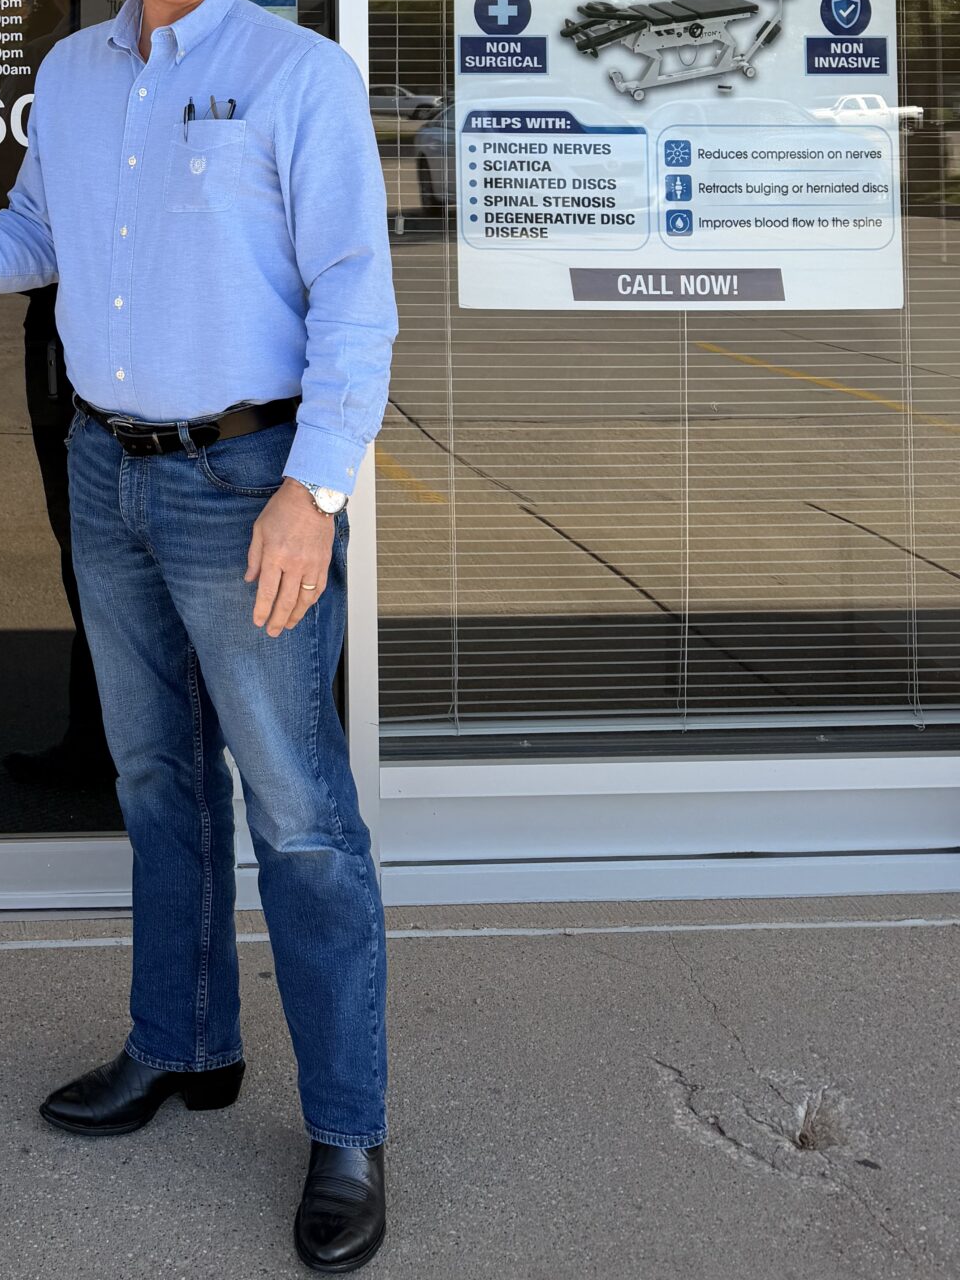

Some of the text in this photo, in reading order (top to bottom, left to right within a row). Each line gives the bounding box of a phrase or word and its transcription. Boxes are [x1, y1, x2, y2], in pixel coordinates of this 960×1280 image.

[486, 42, 521, 53] NON
[830, 42, 864, 54] NON
[465, 56, 542, 68] SURGICAL
[814, 57, 880, 69] INVASIVE
[471, 117, 571, 129] HELPS WITH:
[483, 142, 611, 155] PINCHED NERVES
[697, 148, 882, 161] Reduces compression on nerves
[483, 160, 552, 172] SCIATICA
[483, 178, 617, 190] HERNIATED DISCS
[698, 183, 889, 196] Retracts bulging or herniated discs
[483, 195, 616, 208] SPINAL STENOSIS
[484, 212, 635, 225] DEGENERATIVE DISC
[698, 217, 882, 230] Improves blood flow to the spine
[485, 227, 548, 238] DISEASE
[617, 274, 738, 295] CALL NOW!
